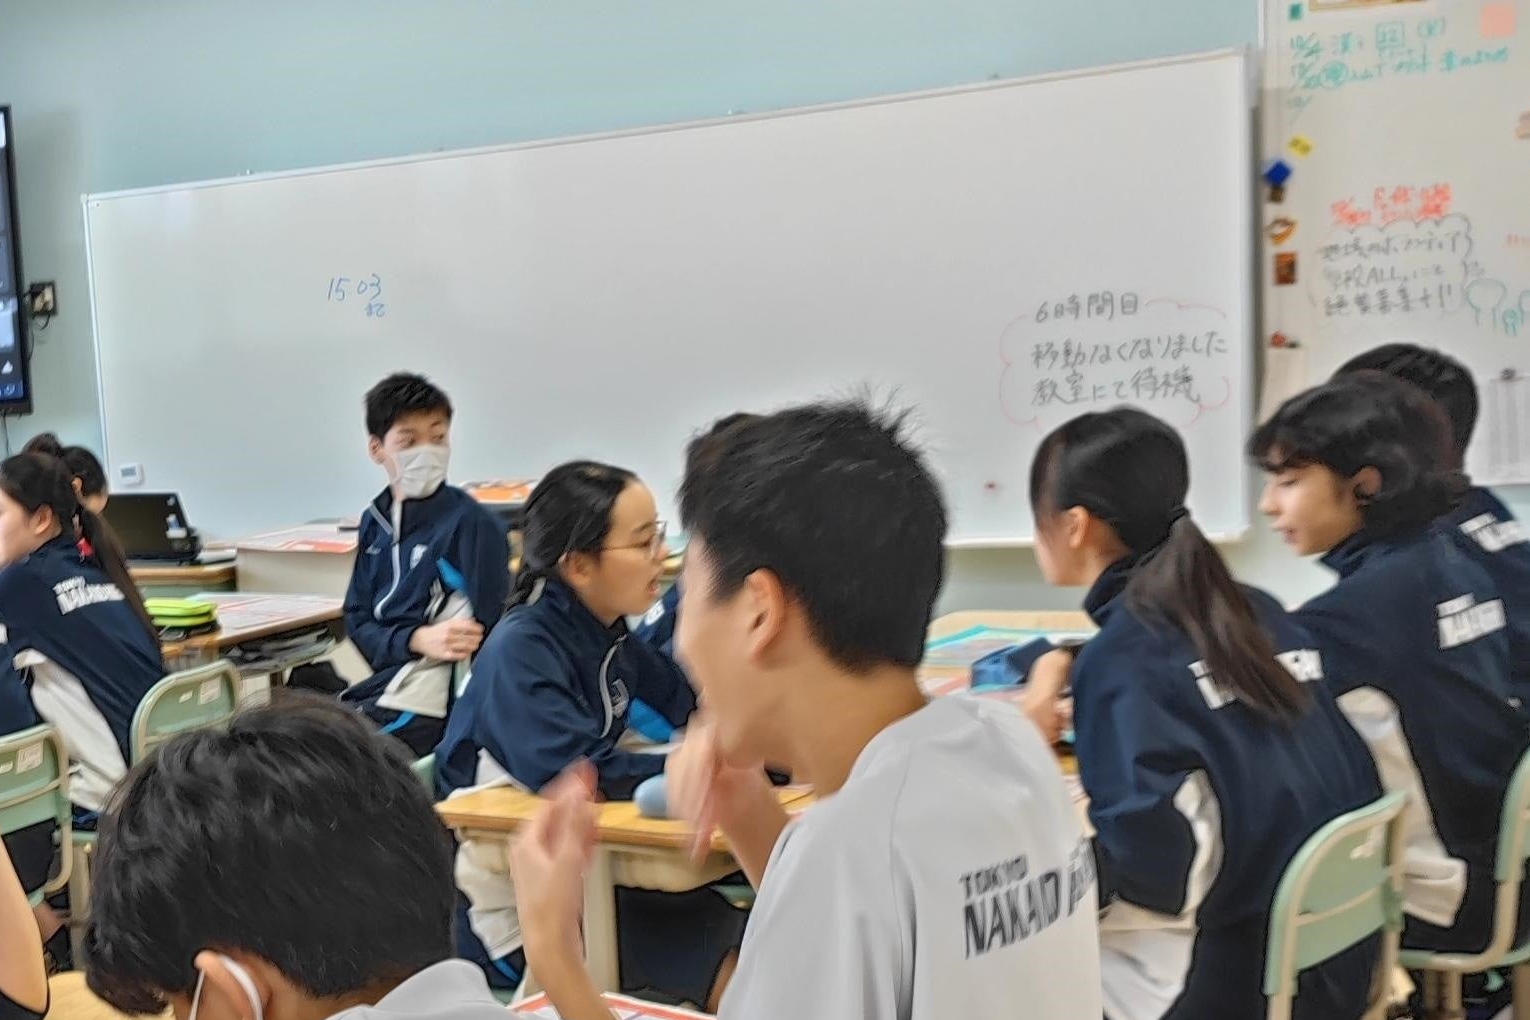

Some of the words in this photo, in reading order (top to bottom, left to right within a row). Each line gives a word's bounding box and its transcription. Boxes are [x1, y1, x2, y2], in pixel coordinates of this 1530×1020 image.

[1030, 331, 1228, 369] 移動なくなりました
